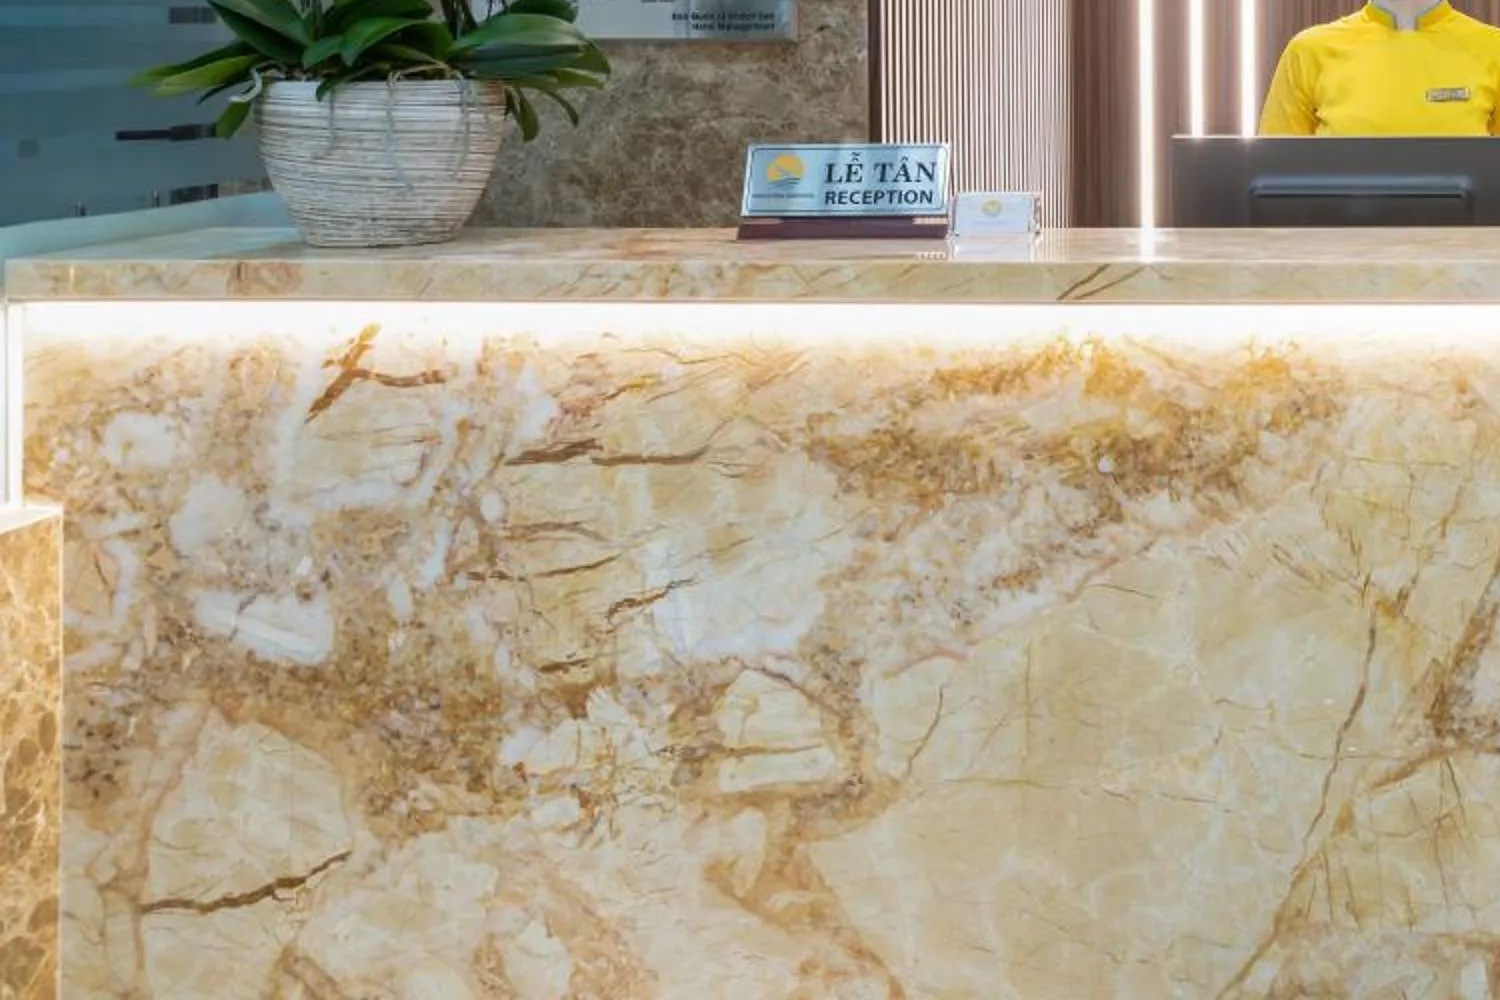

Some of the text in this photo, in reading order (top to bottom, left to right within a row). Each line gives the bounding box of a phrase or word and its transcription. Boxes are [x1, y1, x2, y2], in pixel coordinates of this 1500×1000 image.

[823, 151, 938, 183] LỄ TÂN
[824, 188, 934, 206] RECEPTION
